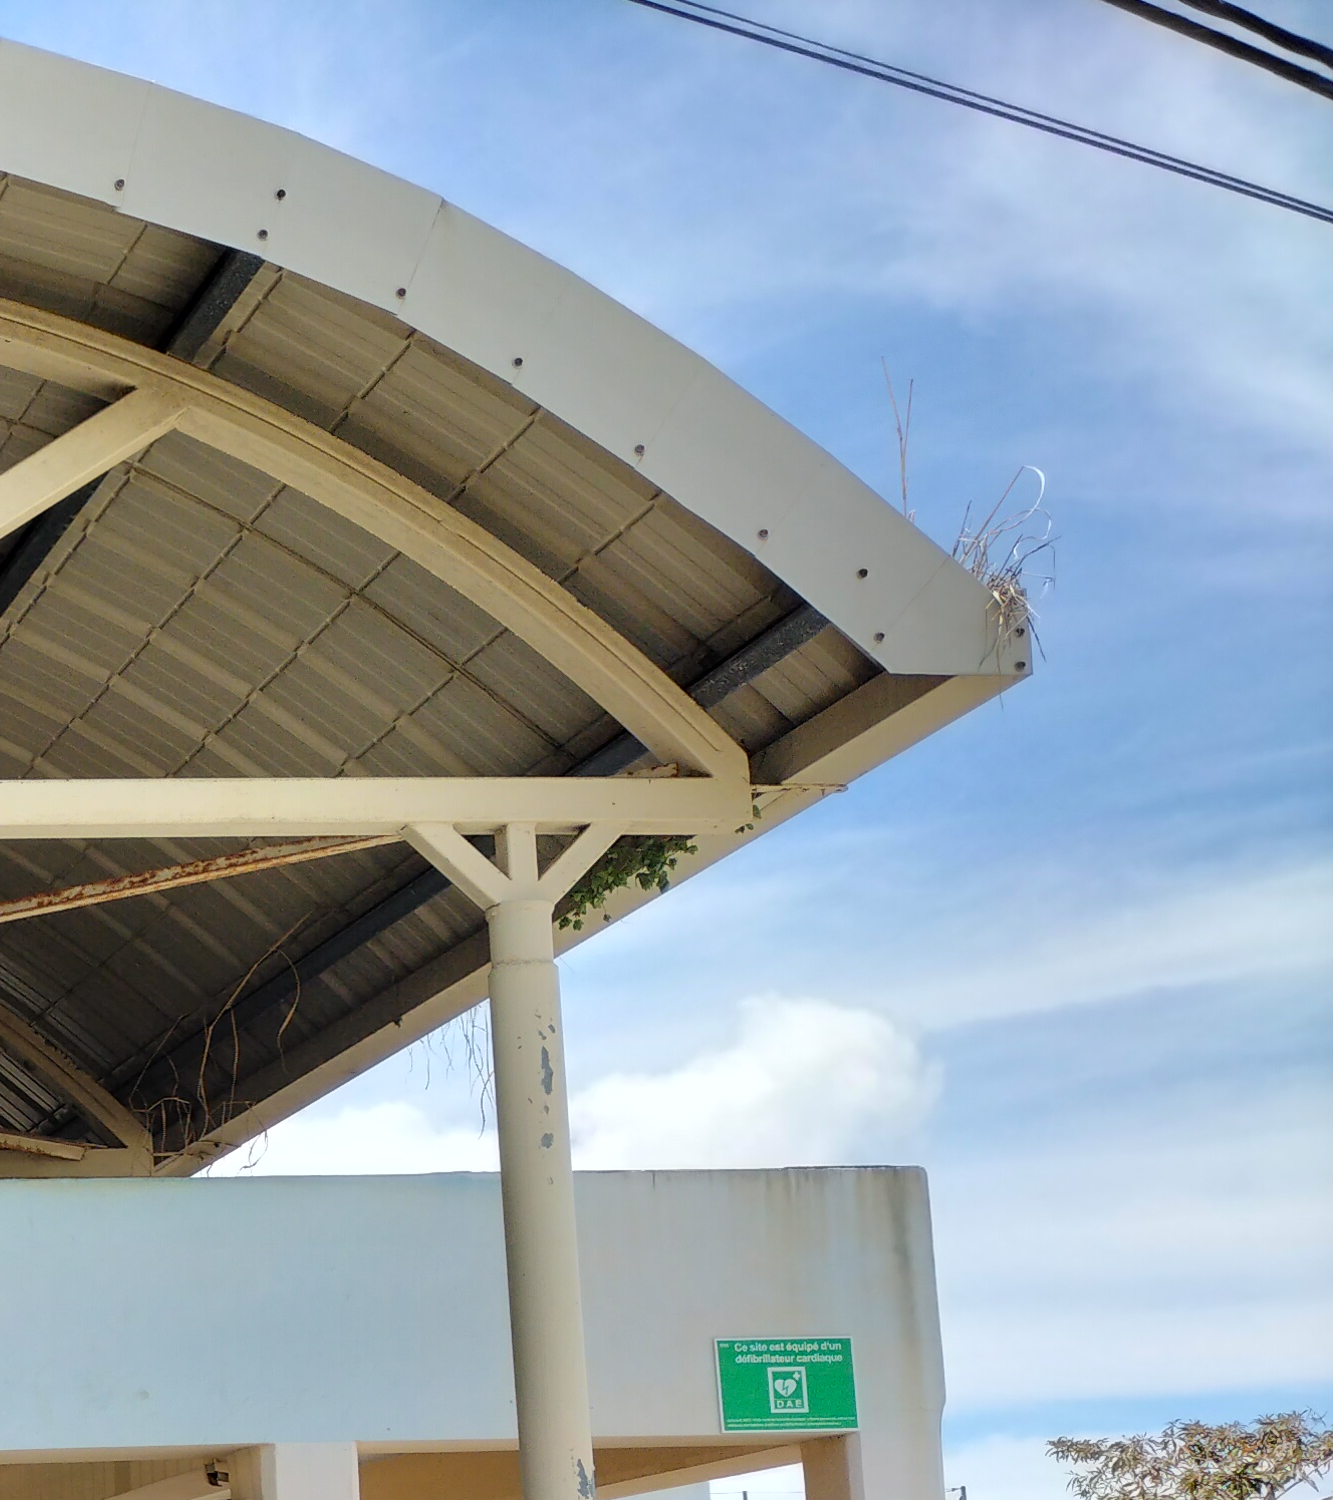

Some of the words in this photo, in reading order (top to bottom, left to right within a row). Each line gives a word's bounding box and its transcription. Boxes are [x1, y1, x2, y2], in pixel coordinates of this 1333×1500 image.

[734, 1343, 748, 1352] Ce
[749, 1342, 767, 1352] site
[769, 1342, 784, 1351] est
[786, 1341, 819, 1353] équipé
[820, 1341, 842, 1351] d'un
[735, 1354, 795, 1364] défibrillateur
[796, 1353, 843, 1364] cardiaque
